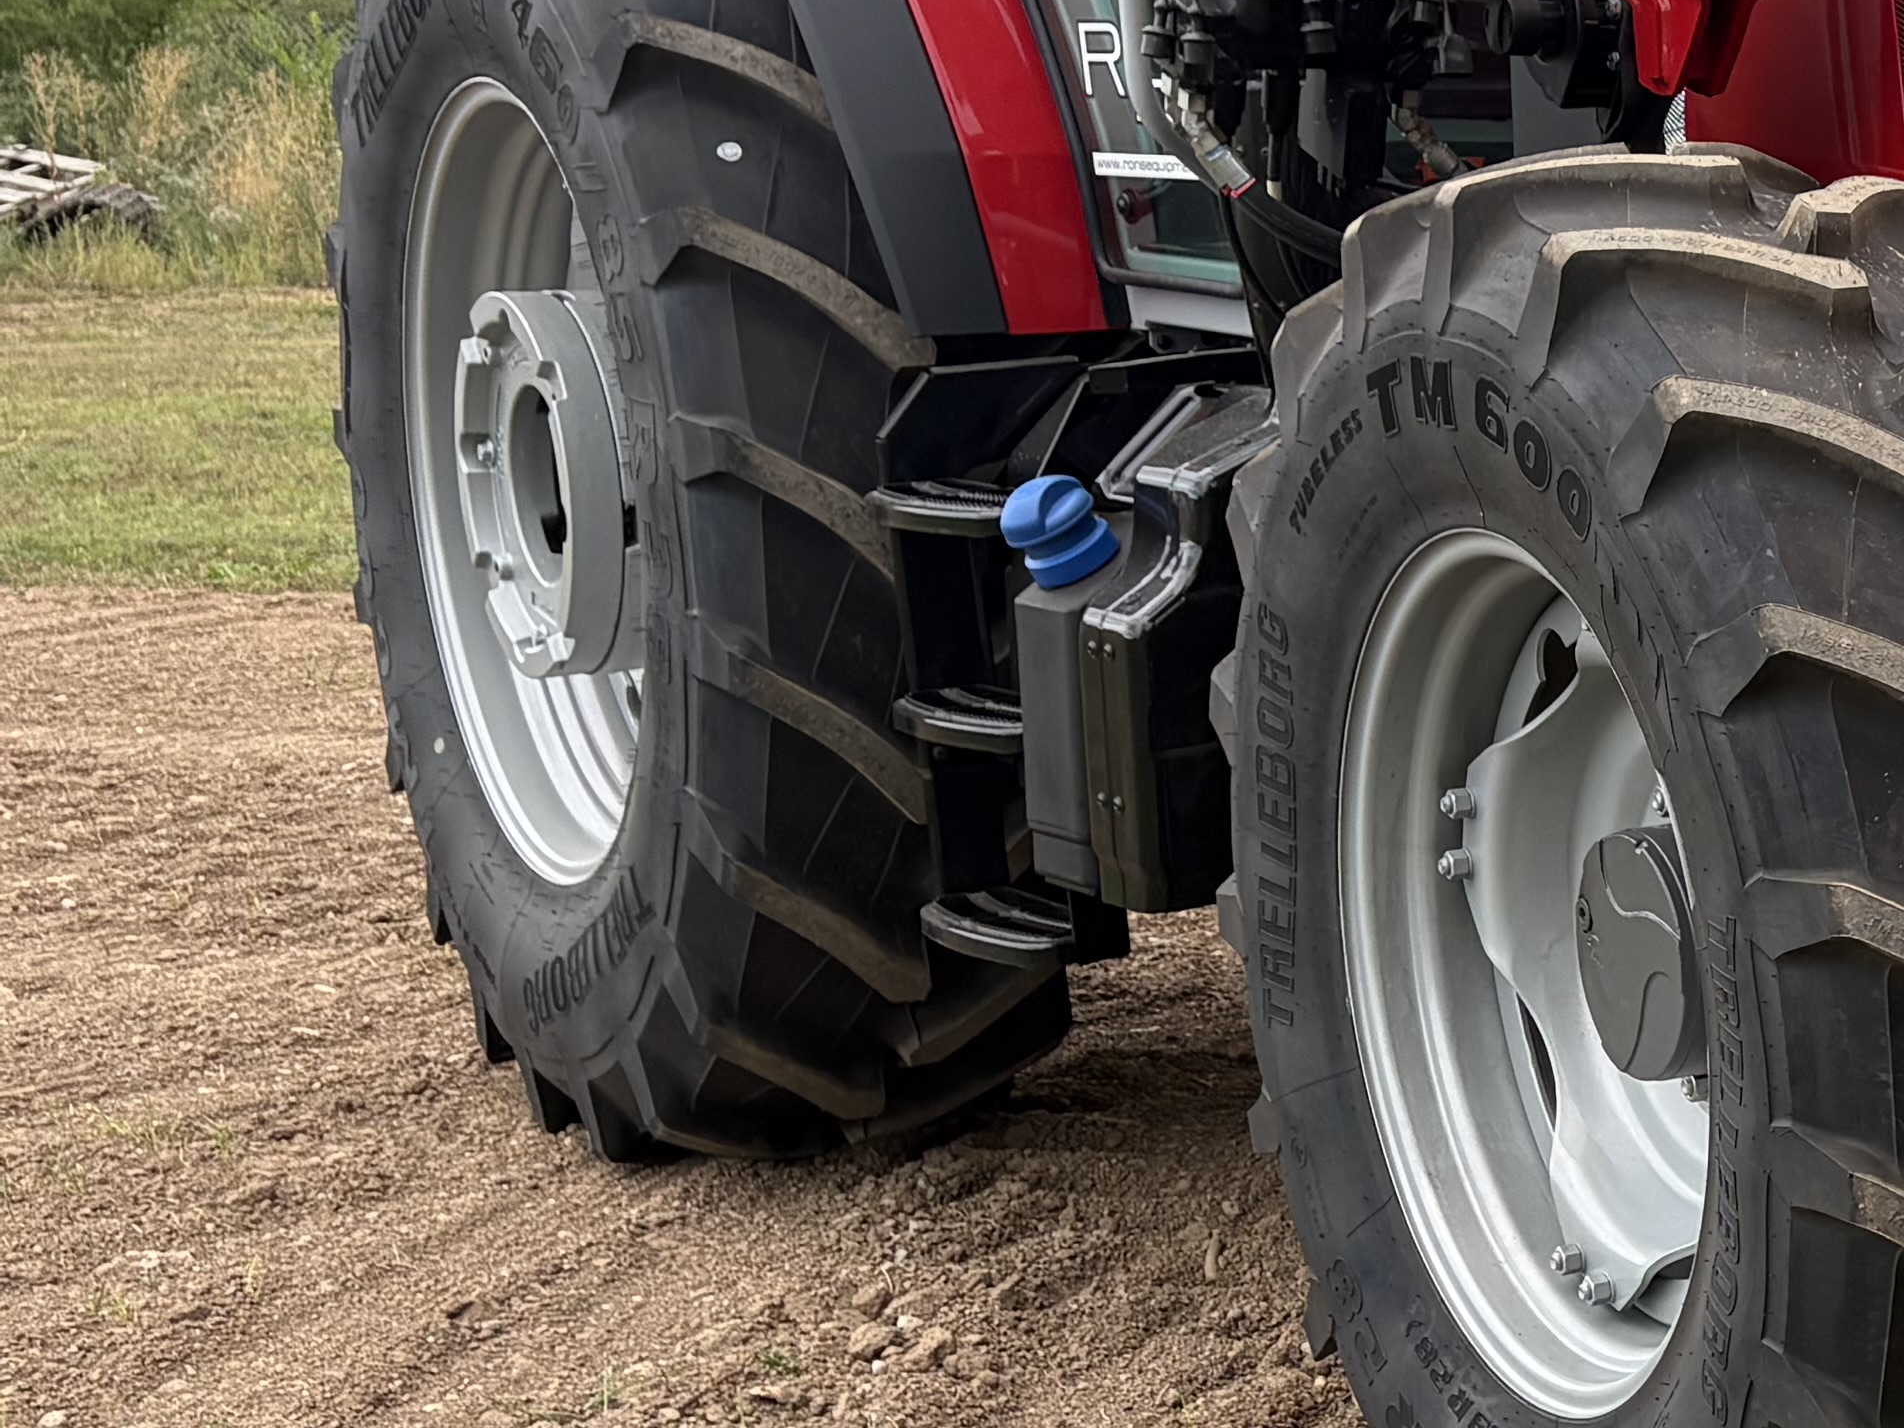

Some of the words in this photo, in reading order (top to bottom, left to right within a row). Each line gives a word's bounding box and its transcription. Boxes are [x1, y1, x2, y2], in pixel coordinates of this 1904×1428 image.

[1077, 21, 1127, 97] R
[1288, 408, 1363, 537] TUBELESS
[1255, 600, 1299, 1031] TRELLEBORG
[522, 865, 657, 1036] TRELLEBORG
[1701, 913, 1744, 1428] TRELLEBORG
